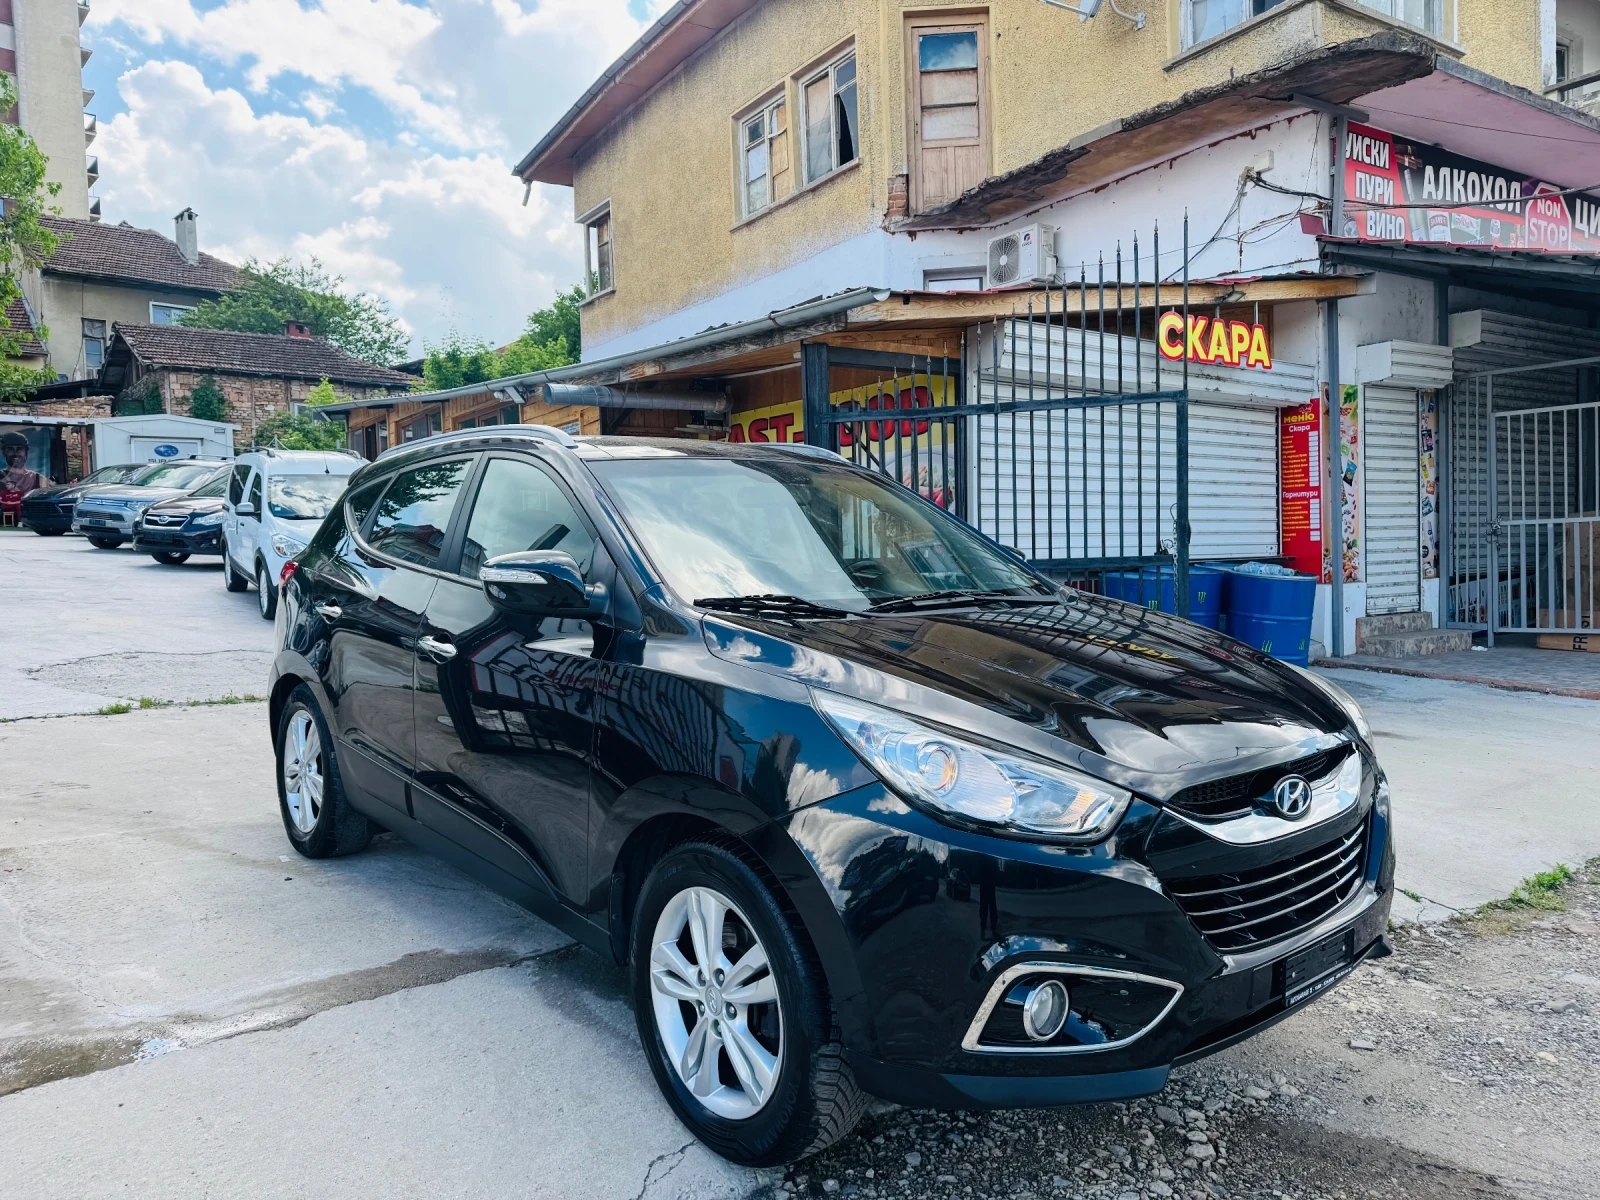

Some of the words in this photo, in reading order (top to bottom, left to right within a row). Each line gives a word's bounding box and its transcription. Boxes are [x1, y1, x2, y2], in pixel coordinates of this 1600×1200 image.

[1355, 170, 1394, 205] ПУРИ
[1422, 165, 1521, 213] АЛКОХОЛ
[1536, 198, 1561, 218] NON
[1366, 210, 1405, 240] ВИНО
[1529, 217, 1568, 248] STOP
[1158, 311, 1272, 369] СКАРА
